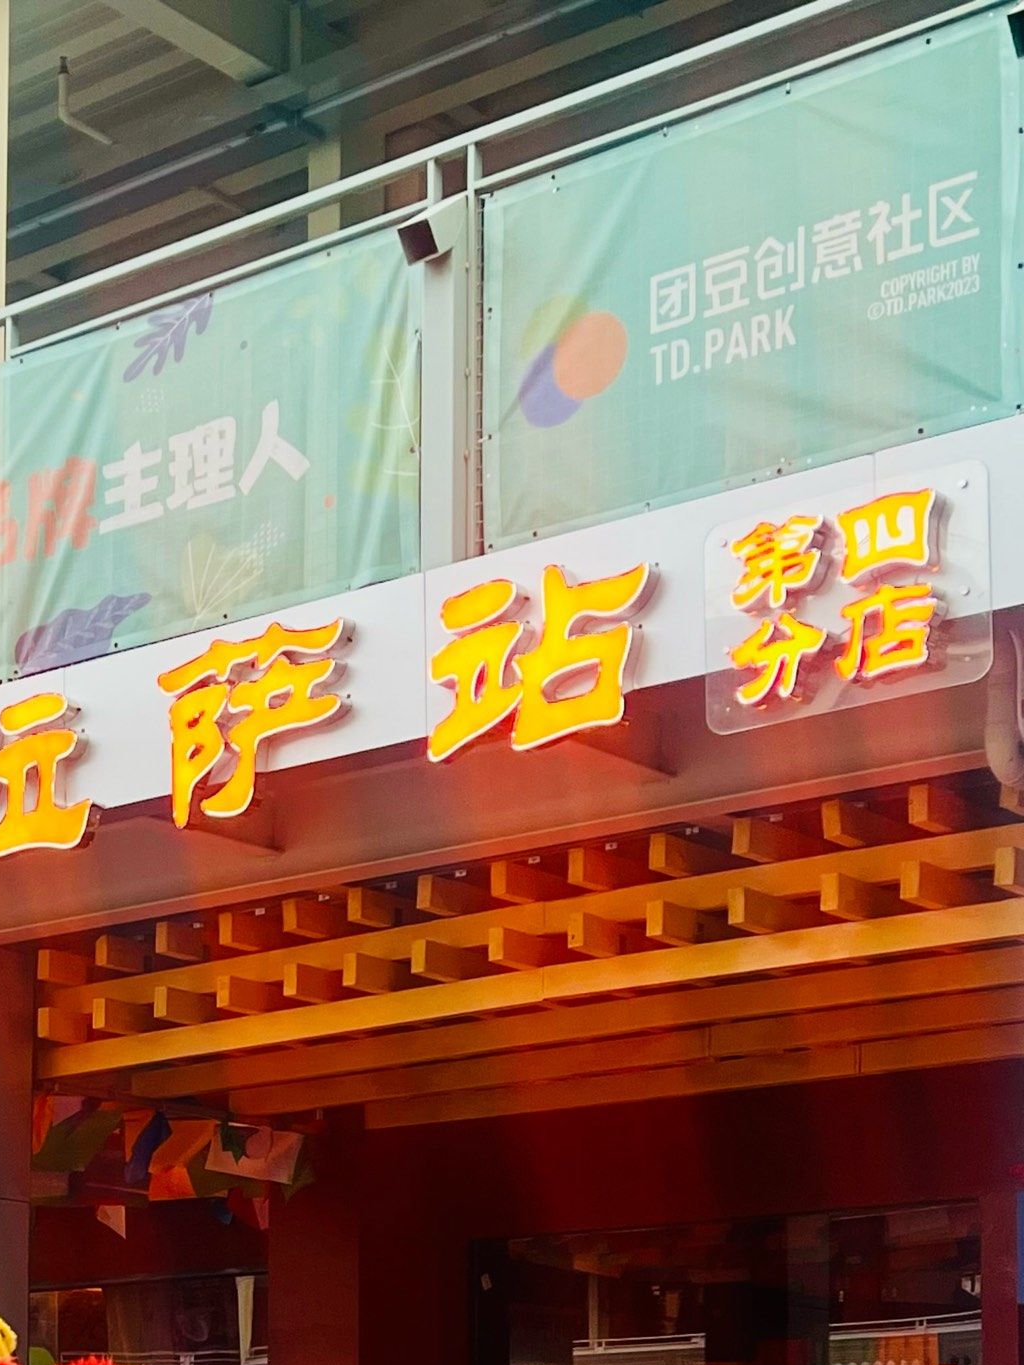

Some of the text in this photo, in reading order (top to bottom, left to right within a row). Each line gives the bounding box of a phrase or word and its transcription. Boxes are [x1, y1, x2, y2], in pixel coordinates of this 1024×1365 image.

[650, 171, 980, 334] 团豆创意社区
[881, 253, 980, 298] COPYRIGHT BY
[650, 305, 796, 385] TD.PARK
[731, 488, 936, 608] 第四
[731, 583, 937, 704] 分店
